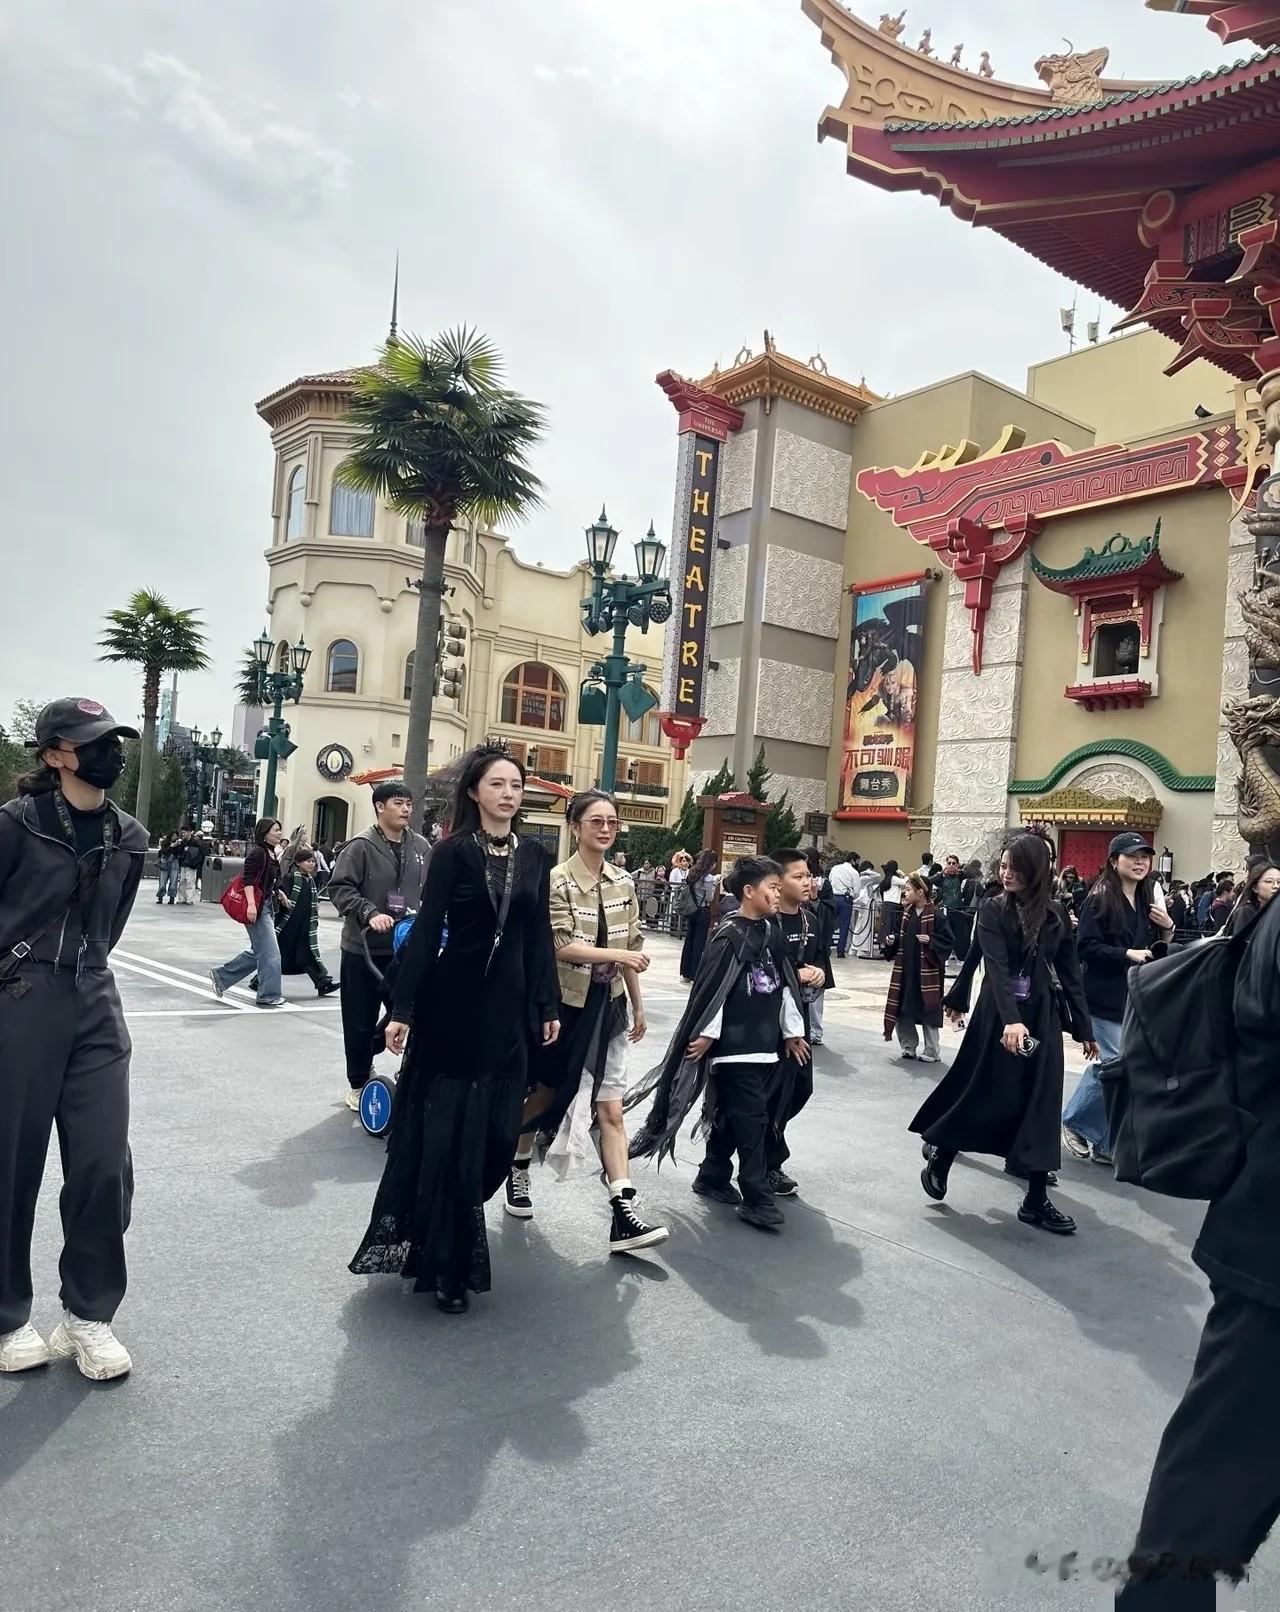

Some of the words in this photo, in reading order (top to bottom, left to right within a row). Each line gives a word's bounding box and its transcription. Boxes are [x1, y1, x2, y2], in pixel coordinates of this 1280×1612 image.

[678, 450, 713, 704] THEATRE
[843, 747, 911, 772] 不可驯服
[860, 777, 892, 791] 舞台秀
[620, 806, 660, 820] ANGERIE
